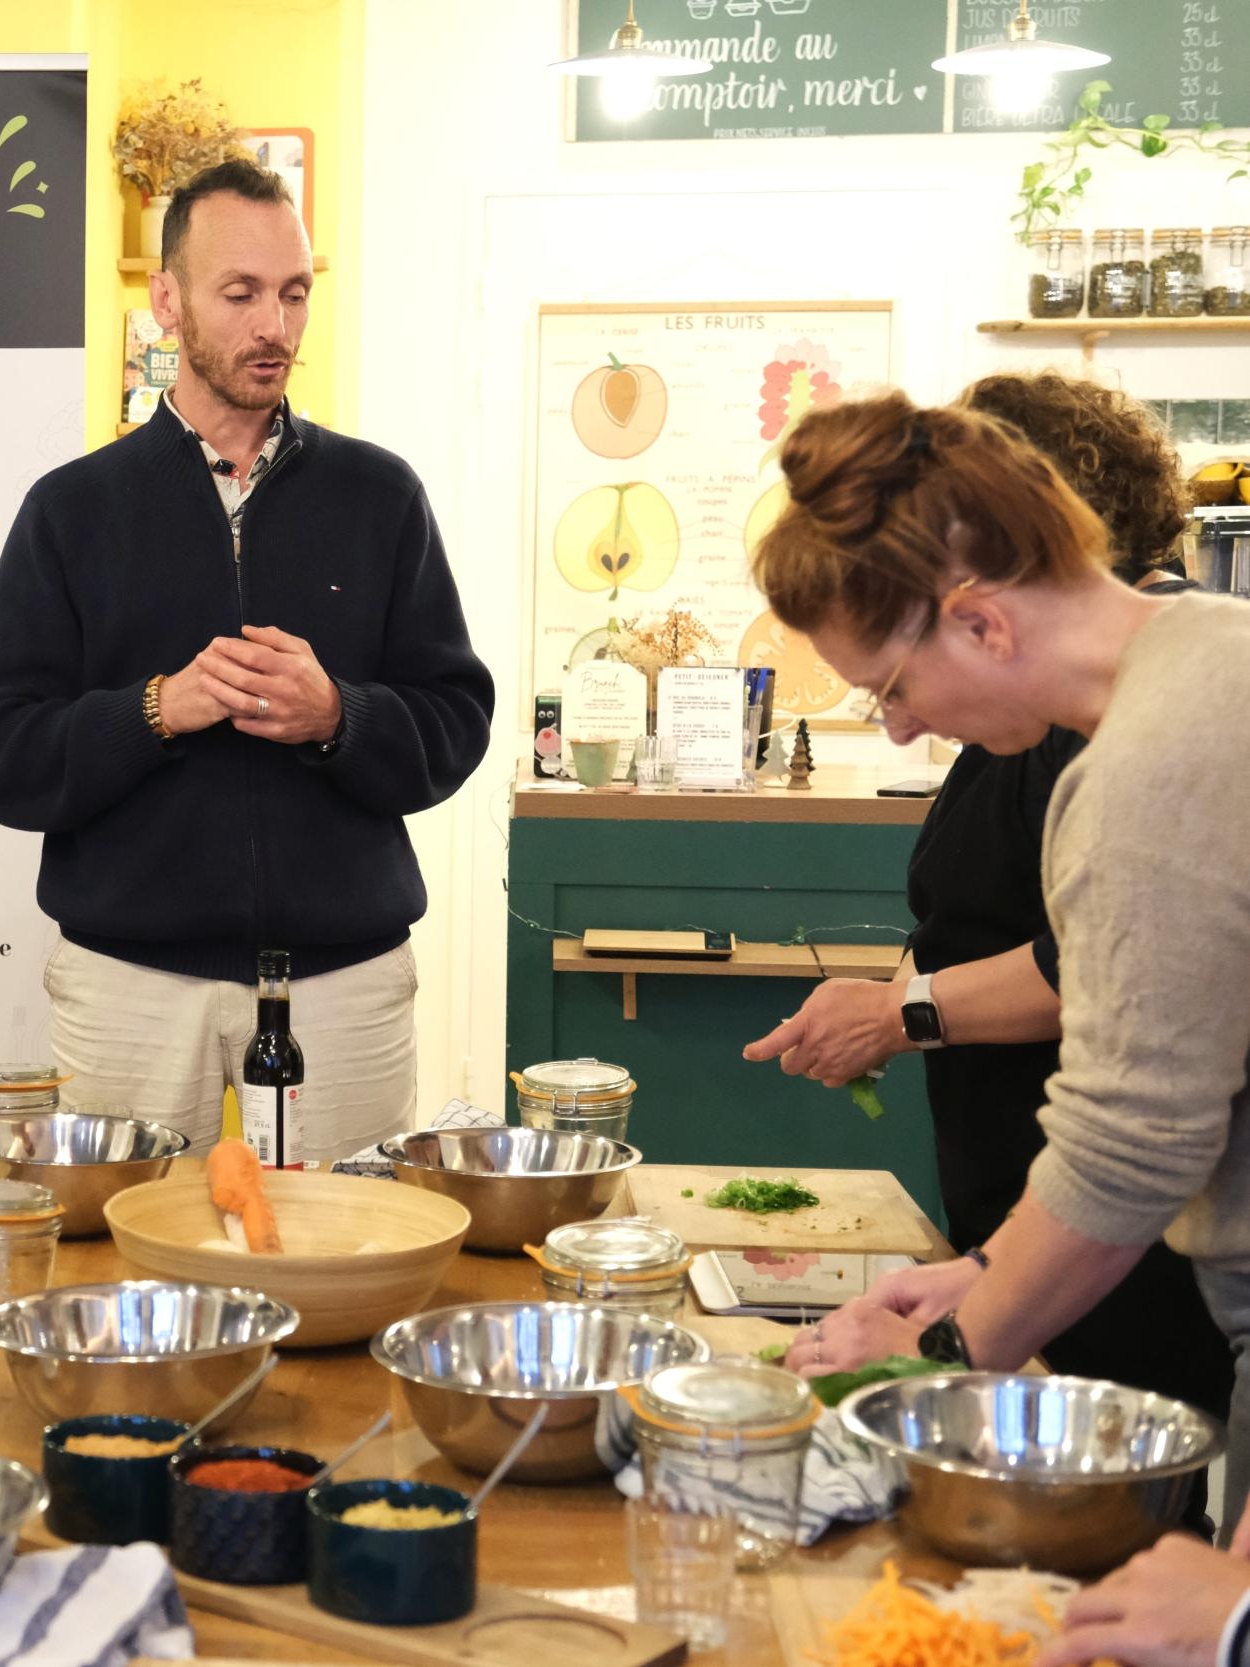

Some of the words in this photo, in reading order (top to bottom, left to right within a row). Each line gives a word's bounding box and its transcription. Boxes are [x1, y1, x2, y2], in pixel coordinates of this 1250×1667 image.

[962, 9, 996, 29] JUS
[1183, 3, 1202, 23] 25
[795, 32, 838, 60] au
[1181, 28, 1202, 48] 33
[1180, 52, 1203, 74] 33
[803, 69, 903, 106] merci
[1179, 77, 1201, 97] 33
[1177, 101, 1200, 122] 33
[665, 316, 694, 331] LES
[705, 315, 766, 331] FRUITS
